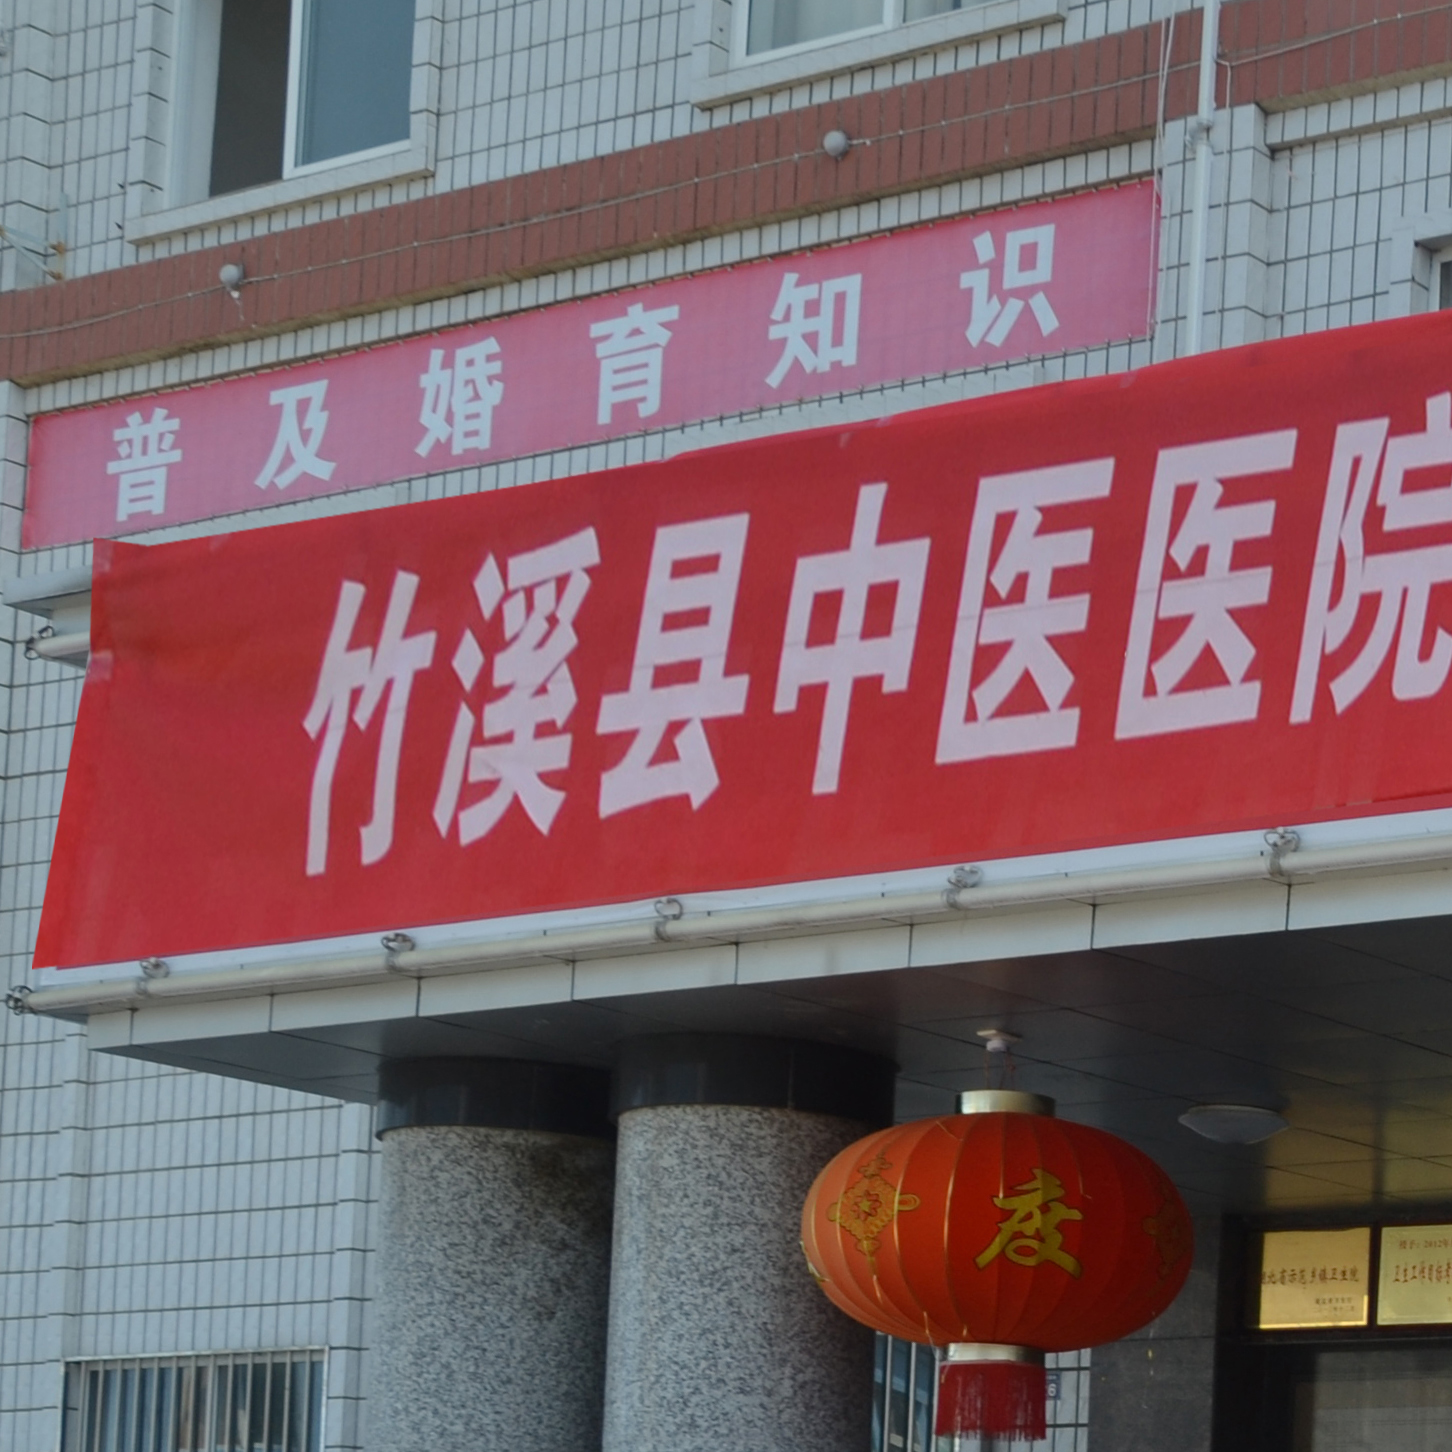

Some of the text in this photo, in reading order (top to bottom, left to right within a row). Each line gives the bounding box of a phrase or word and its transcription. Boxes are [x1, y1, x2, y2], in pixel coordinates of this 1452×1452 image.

[107, 222, 1062, 523] 普及婚育知识
